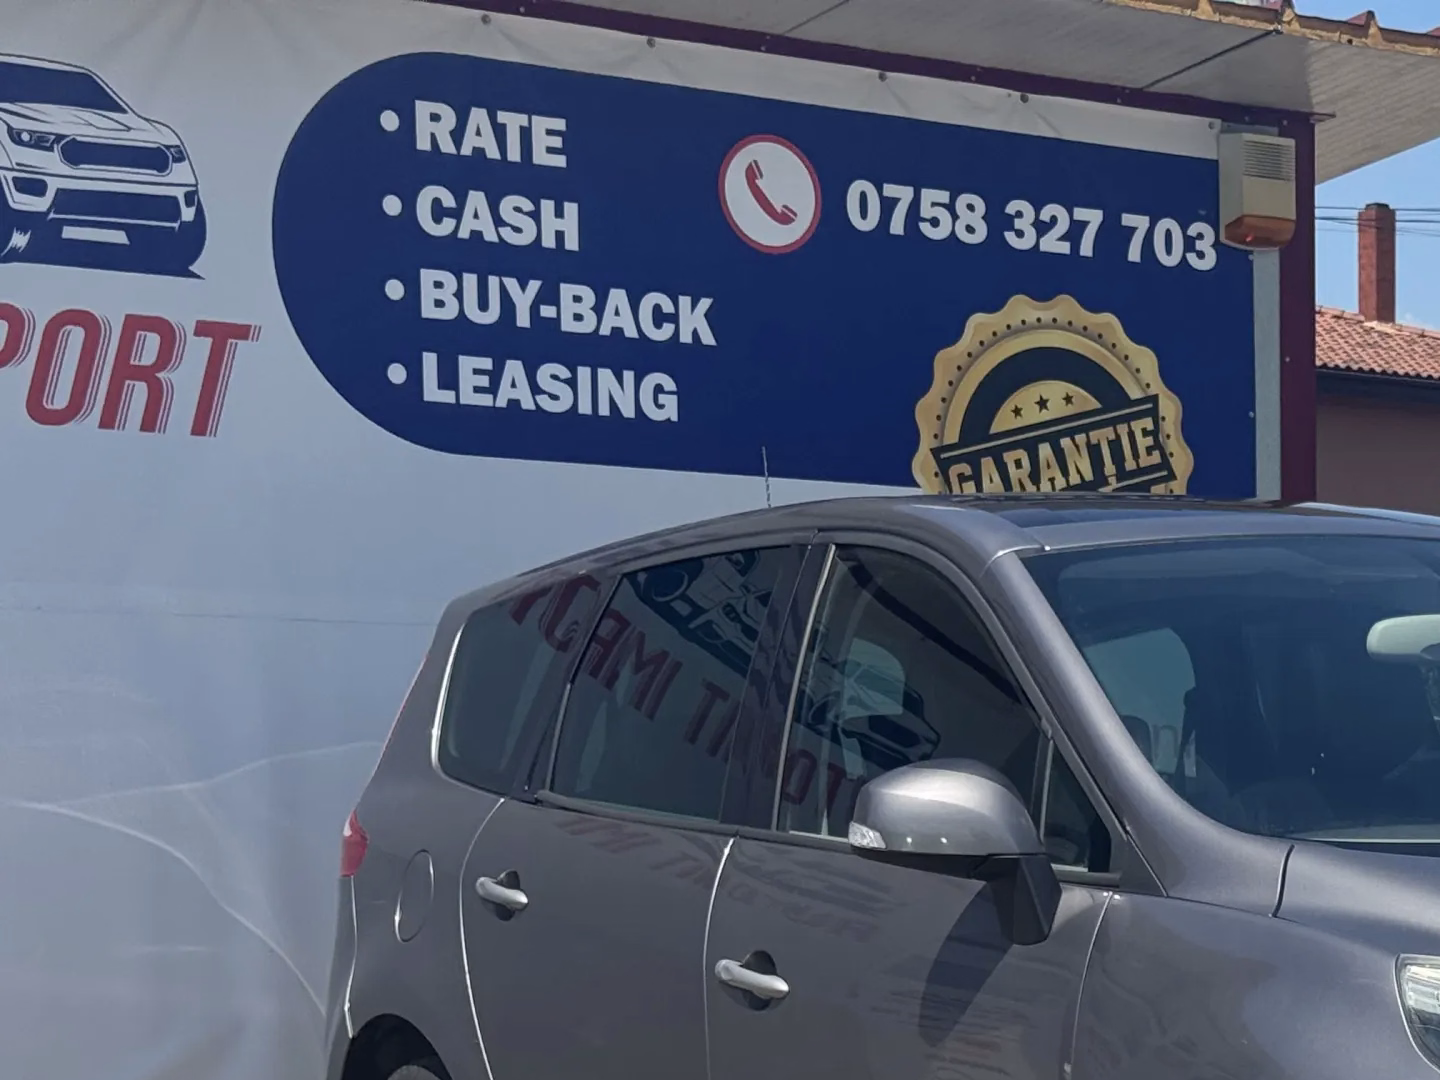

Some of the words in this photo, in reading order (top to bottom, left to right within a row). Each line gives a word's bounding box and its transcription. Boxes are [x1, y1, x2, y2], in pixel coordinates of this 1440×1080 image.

[414, 100, 567, 168] RATE
[416, 185, 580, 252] CASH
[847, 179, 988, 245] 0758
[1003, 199, 1104, 258] 327
[1120, 212, 1217, 271] 703
[419, 268, 717, 347] BUY-BACK
[421, 351, 679, 423] LEASING
